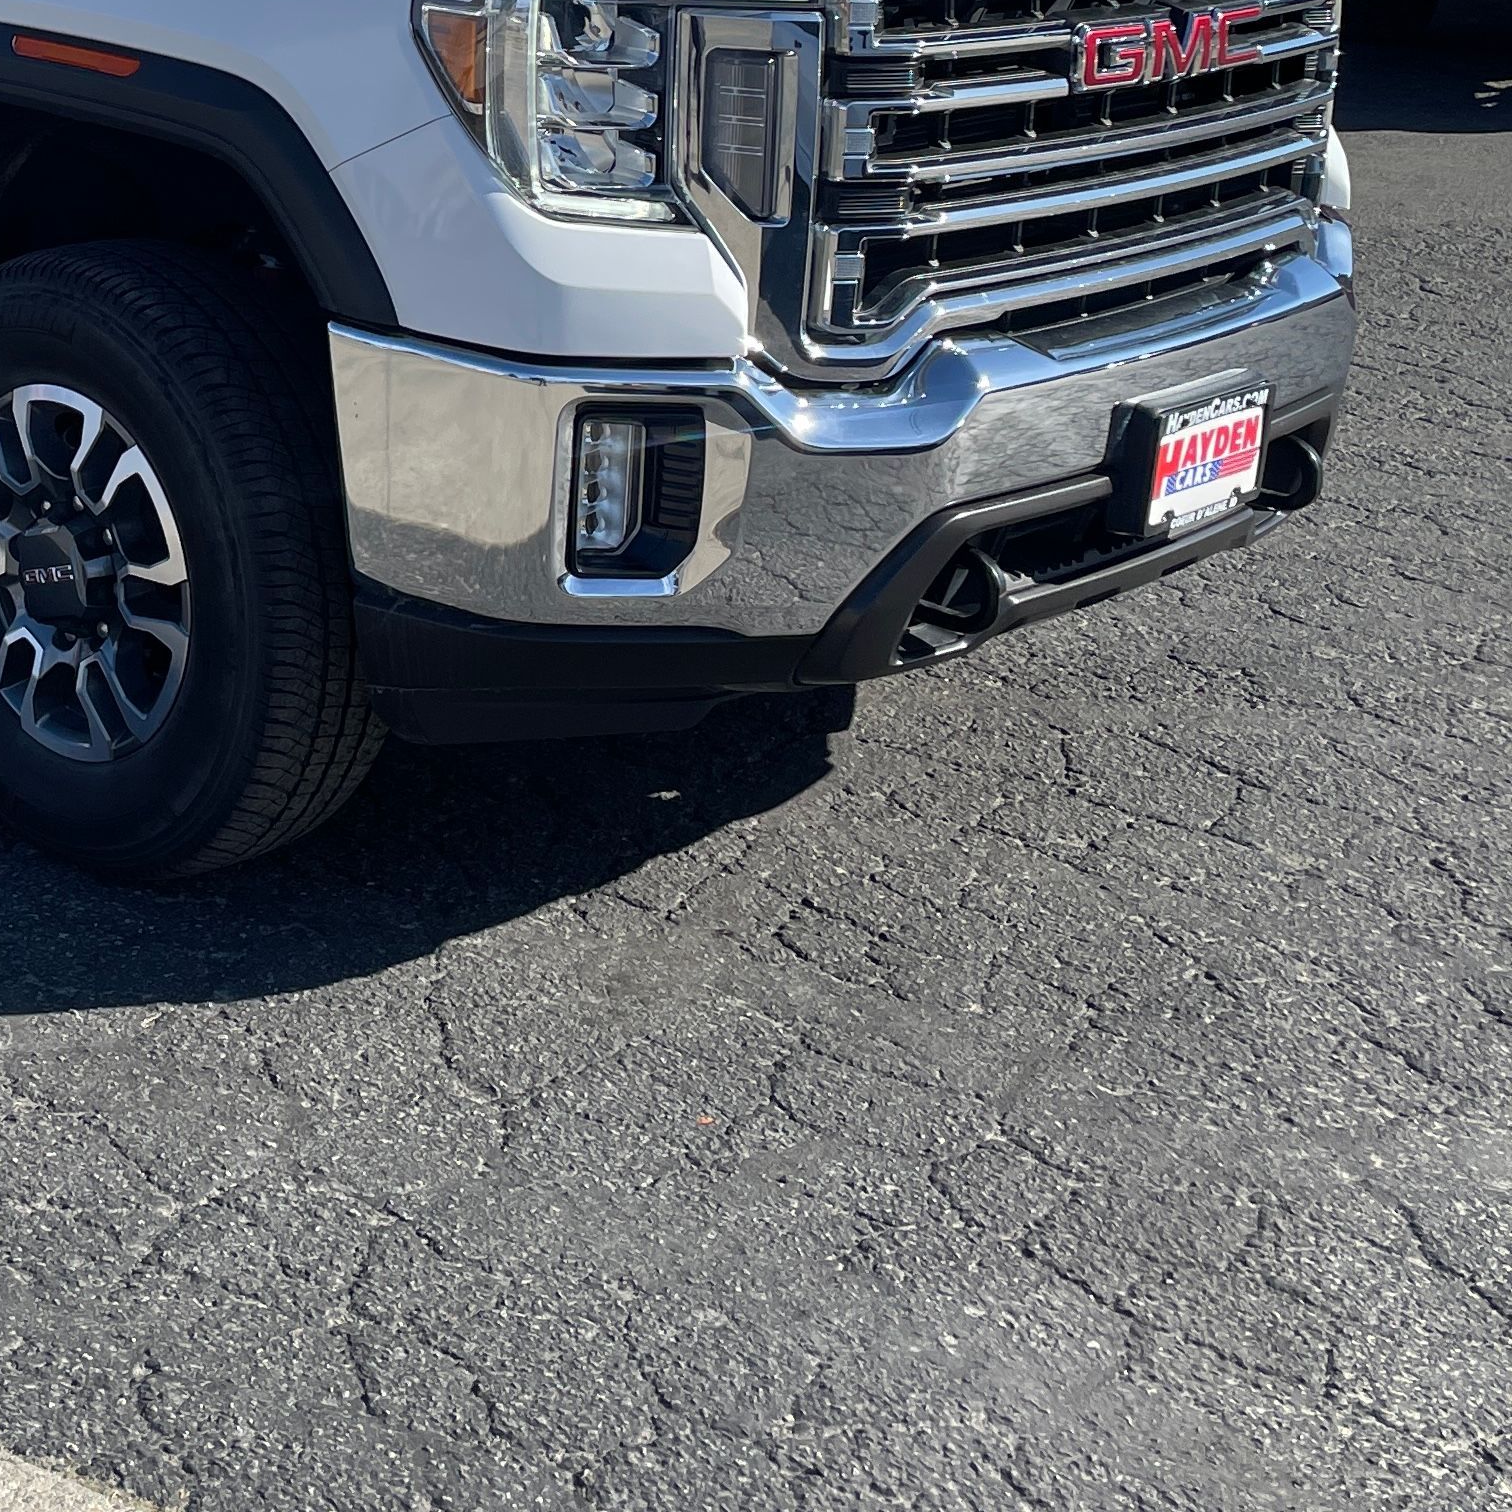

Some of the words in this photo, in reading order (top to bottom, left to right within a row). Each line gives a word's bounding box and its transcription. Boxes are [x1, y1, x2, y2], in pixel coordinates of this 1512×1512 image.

[1076, 3, 1264, 92] GMC
[1152, 414, 1261, 500] HAYDEN
[1175, 461, 1214, 491] CARS
[24, 564, 74, 585] GMC
